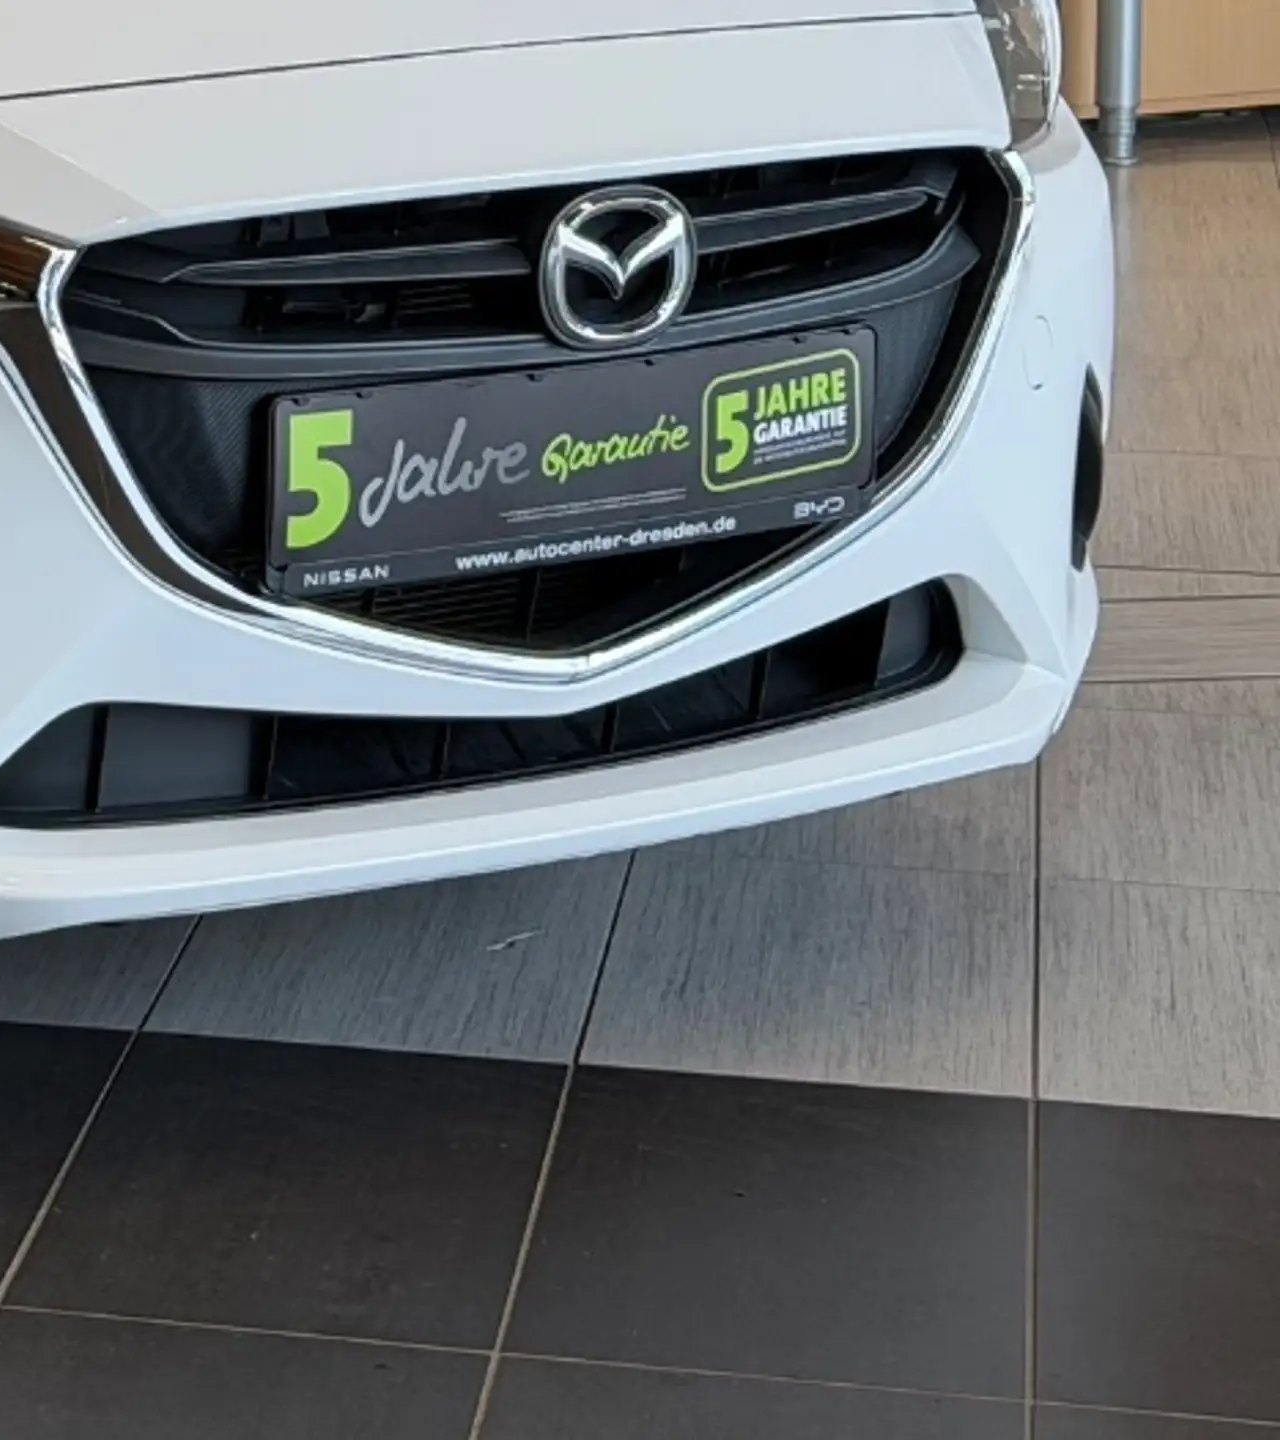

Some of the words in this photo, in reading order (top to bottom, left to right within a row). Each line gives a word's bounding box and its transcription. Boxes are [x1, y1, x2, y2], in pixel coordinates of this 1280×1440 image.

[715, 389, 749, 474] 5
[753, 367, 847, 420] JAHRE
[753, 403, 848, 445] GARANTIE
[286, 409, 353, 548] 5
[358, 416, 530, 528] Jahre
[541, 413, 691, 484] Garantie
[303, 564, 390, 588] NISSAN
[455, 514, 737, 571] www.autocenter-dresden.de
[793, 495, 846, 520] BYD
